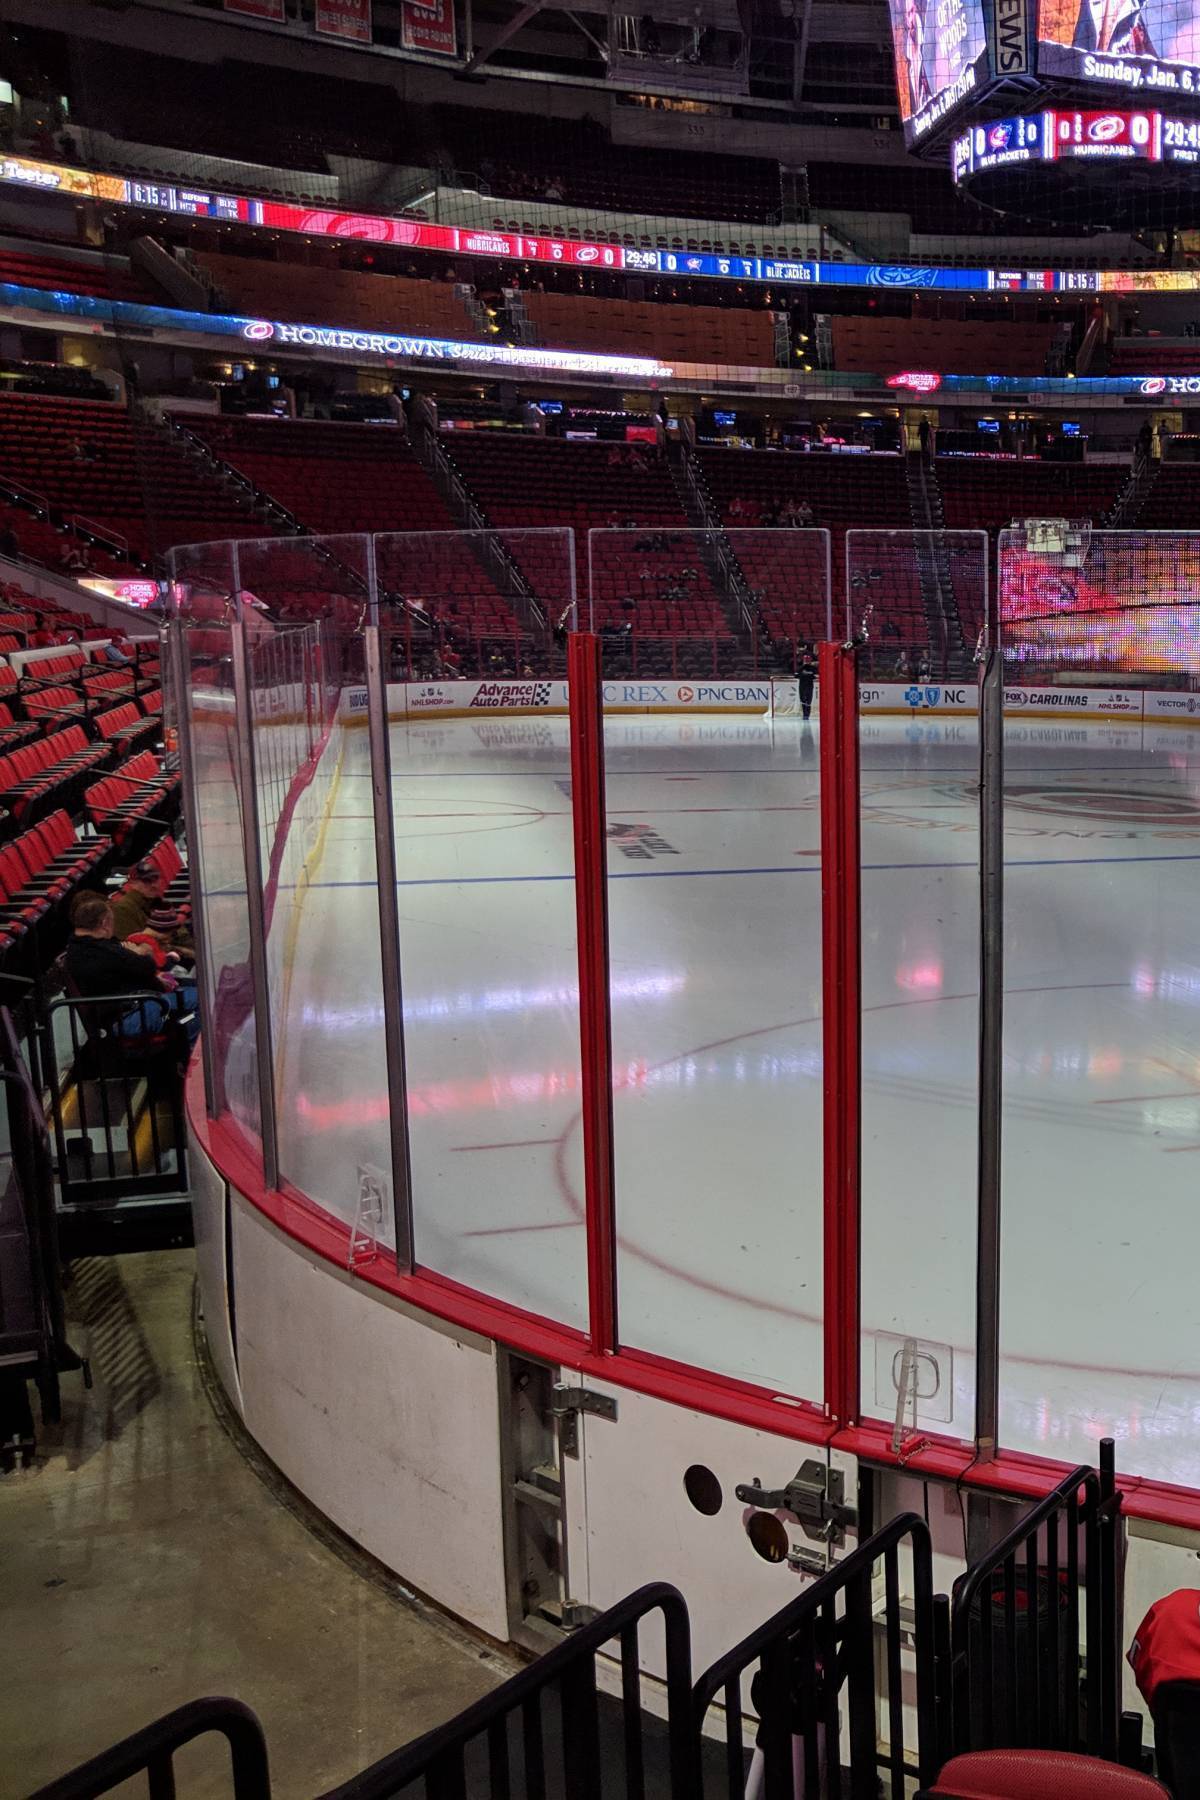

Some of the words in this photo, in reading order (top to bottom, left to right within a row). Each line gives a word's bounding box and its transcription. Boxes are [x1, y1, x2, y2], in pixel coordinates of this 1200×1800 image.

[1084, 56, 1144, 87] Sunday,
[1147, 65, 1179, 88] Jan.
[1182, 70, 1195, 91] 6,
[1027, 124, 1037, 141] 0
[1060, 121, 1069, 139] 0
[1132, 115, 1149, 144] 0
[976, 129, 985, 155] 0
[981, 155, 996, 167] BLUE
[998, 148, 1030, 164] JACKETS
[1074, 144, 1135, 156] HURRICANES
[1173, 149, 1198, 162] FIRST
[134, 187, 158, 205] 6:15
[228, 210, 238, 219] TK
[467, 238, 511, 254] HURRICANES
[553, 249, 562, 259] 0
[604, 249, 613, 265] 0
[626, 250, 656, 265] 29:46
[668, 254, 677, 270] 0
[720, 264, 729, 274] 0
[766, 266, 783, 278] BLUE
[784, 267, 811, 280] JACKETS
[1068, 273, 1087, 289] 6:15
[279, 324, 446, 358] HOMEGROWN
[453, 343, 496, 362] Series
[476, 683, 533, 696] Advance
[621, 686, 669, 702] REX
[944, 690, 966, 704] NC
[1005, 692, 1022, 701] FOX
[469, 696, 498, 707] Auto
[500, 695, 531, 707] Parts
[1029, 693, 1089, 706] CAROLINAS
[1157, 699, 1187, 709] VECTOR
